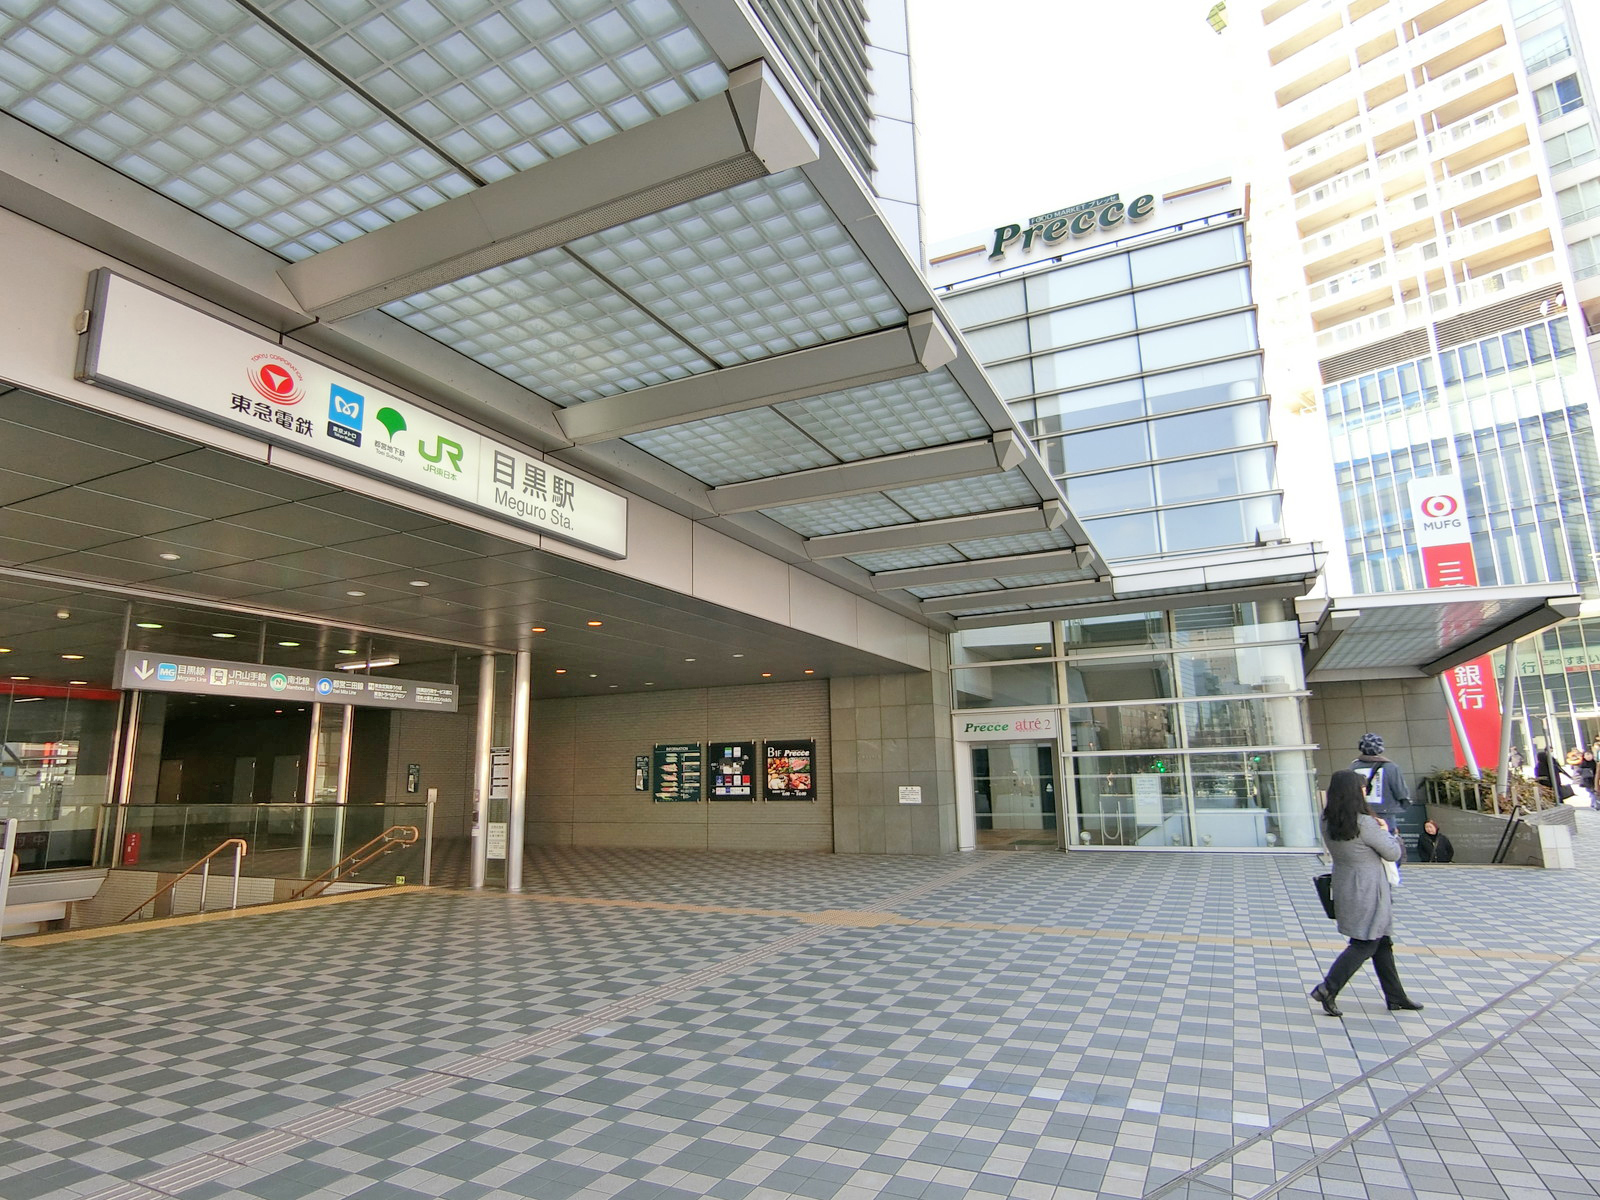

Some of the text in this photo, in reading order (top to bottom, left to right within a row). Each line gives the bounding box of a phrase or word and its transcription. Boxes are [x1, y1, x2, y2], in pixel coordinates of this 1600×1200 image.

[1031, 214, 1052, 224] FOOD
[1054, 204, 1087, 217] MARKET
[988, 194, 1154, 261] Precce
[251, 353, 304, 381] TOKYU CORPORATION
[230, 392, 314, 438] 東急電鉄
[332, 425, 357, 439] 東京メトロ
[374, 440, 406, 457] 都営地下鉄
[376, 448, 404, 463] Toei Subway
[418, 435, 464, 473] JR
[422, 464, 458, 481] JR東日本
[493, 450, 575, 512] 目黒駅
[495, 487, 574, 531] Meguro Sta.
[1424, 519, 1461, 531] MUFG
[159, 668, 176, 676] MG
[177, 664, 206, 676] 目黒線
[228, 669, 267, 681] JR山手線
[177, 675, 195, 683] Meguro
[287, 676, 310, 685] 南北線
[333, 680, 364, 690] 都営三田線
[1454, 664, 1485, 709] 銀行
[964, 718, 1051, 733] Precce atré 2
